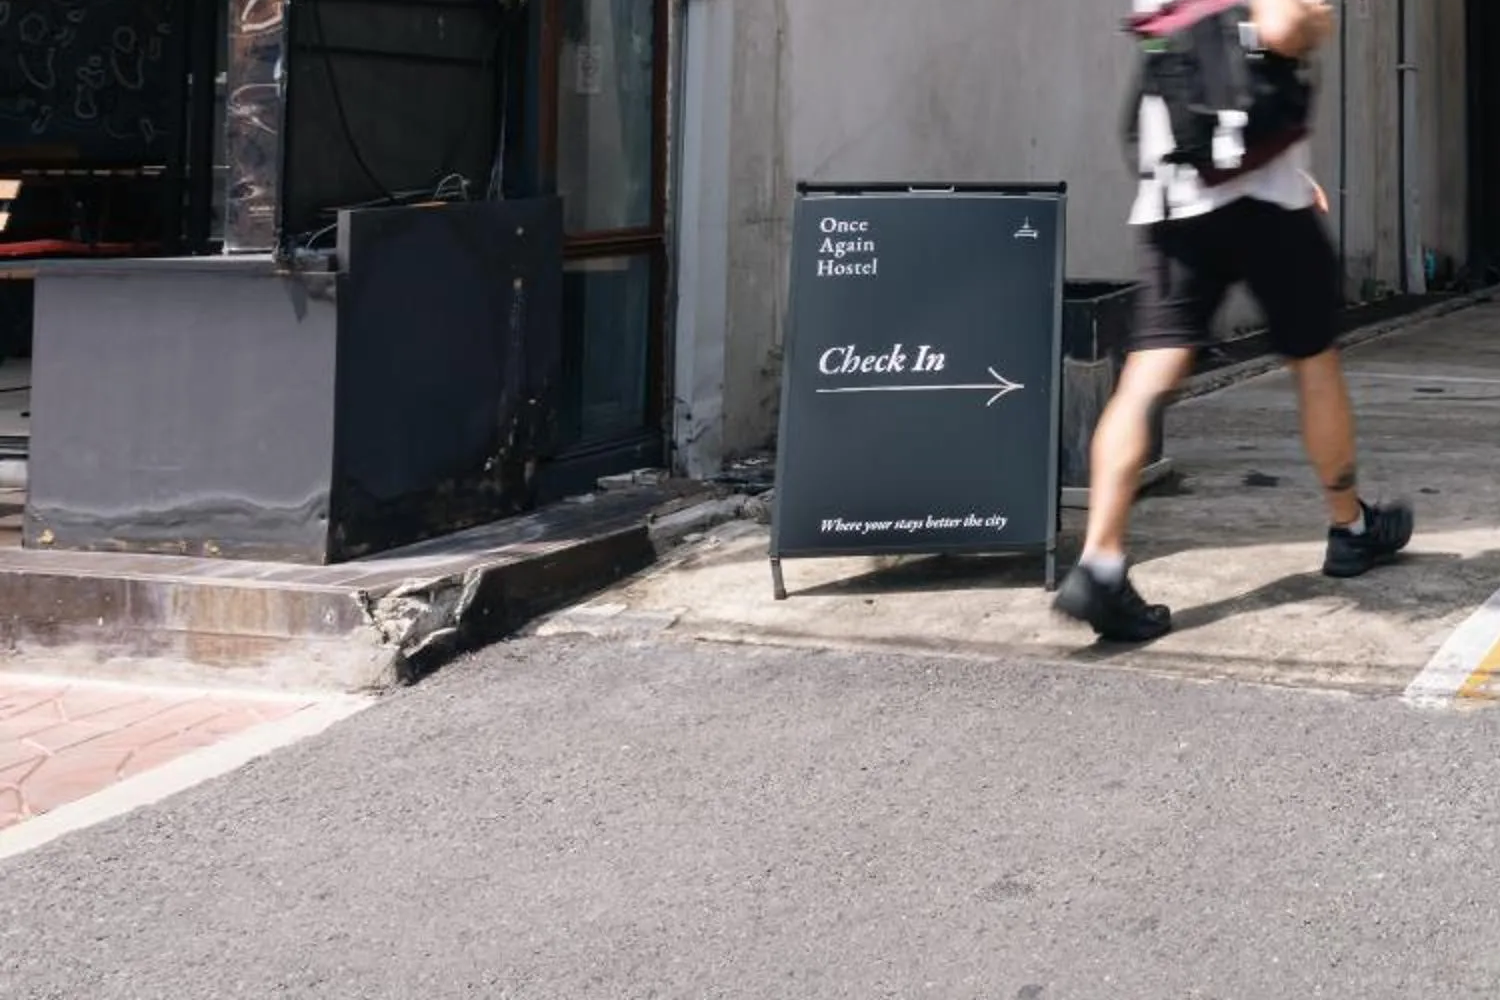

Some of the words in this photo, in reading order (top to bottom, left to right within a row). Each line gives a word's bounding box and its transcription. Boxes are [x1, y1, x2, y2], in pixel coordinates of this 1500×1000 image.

[819, 217, 869, 233] Once
[819, 237, 875, 258] Again
[816, 258, 878, 277] Hostel
[818, 344, 905, 375] Check
[911, 345, 945, 372] In
[821, 517, 862, 533] Where
[862, 519, 893, 535] your
[894, 517, 925, 533] stays
[925, 514, 963, 529] better
[963, 513, 984, 528] the
[985, 512, 1008, 531] city
